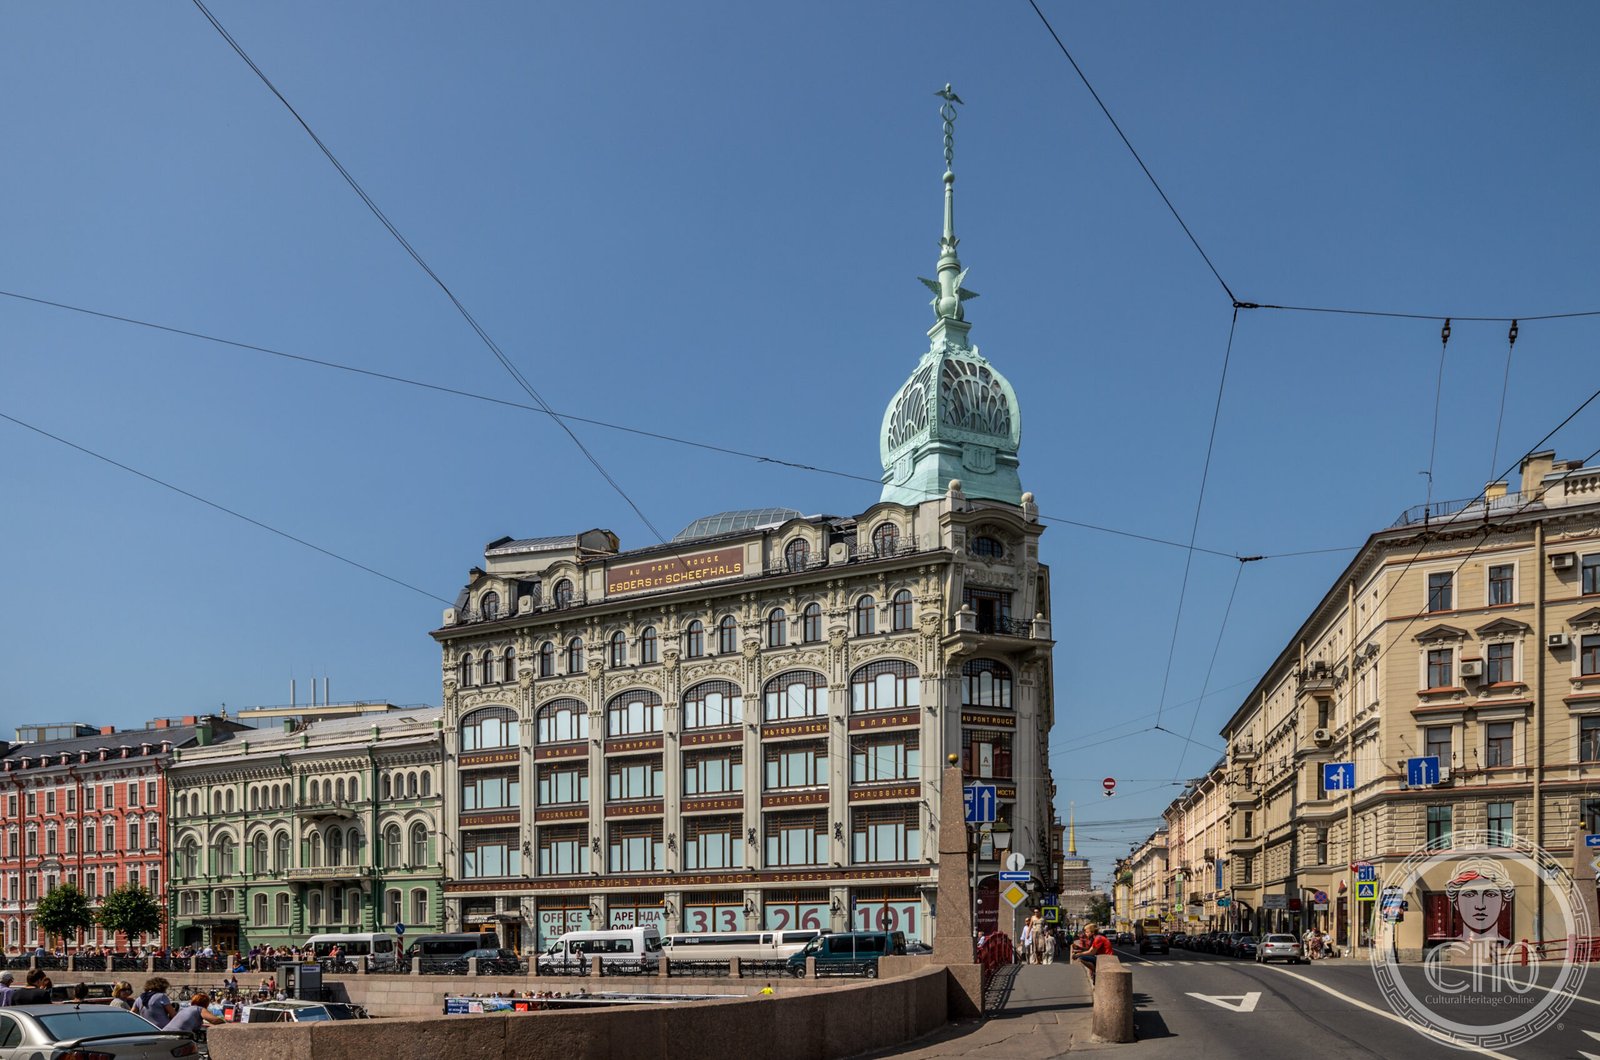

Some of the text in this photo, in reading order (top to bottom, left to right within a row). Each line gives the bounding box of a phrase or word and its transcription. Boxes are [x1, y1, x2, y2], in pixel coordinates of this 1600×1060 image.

[651, 563, 675, 572] PONT
[686, 555, 719, 567] ROUGE
[609, 578, 652, 593] ESDERS
[665, 563, 741, 584] SCHEEFHALS
[860, 716, 908, 727] ШЛЯПЫ
[992, 717, 1014, 725] ROUGE
[692, 733, 732, 743] ОБУВЬ
[612, 740, 657, 750] ТУЖУРКИ
[854, 788, 916, 799] CHAUSSURES
[686, 800, 738, 810] CHAPEAUX
[768, 794, 823, 805] GANTERIE
[612, 805, 657, 814] LINGERIE
[568, 877, 630, 888] МАГАЗИНЪ
[635, 878, 642, 886] У
[648, 875, 711, 886] КРАСНАГО
[718, 874, 761, 884] МОСТА
[542, 912, 583, 924] OFFICE
[614, 911, 661, 921] АРЕНДА
[857, 906, 915, 934] 101
[550, 925, 581, 935] RENT
